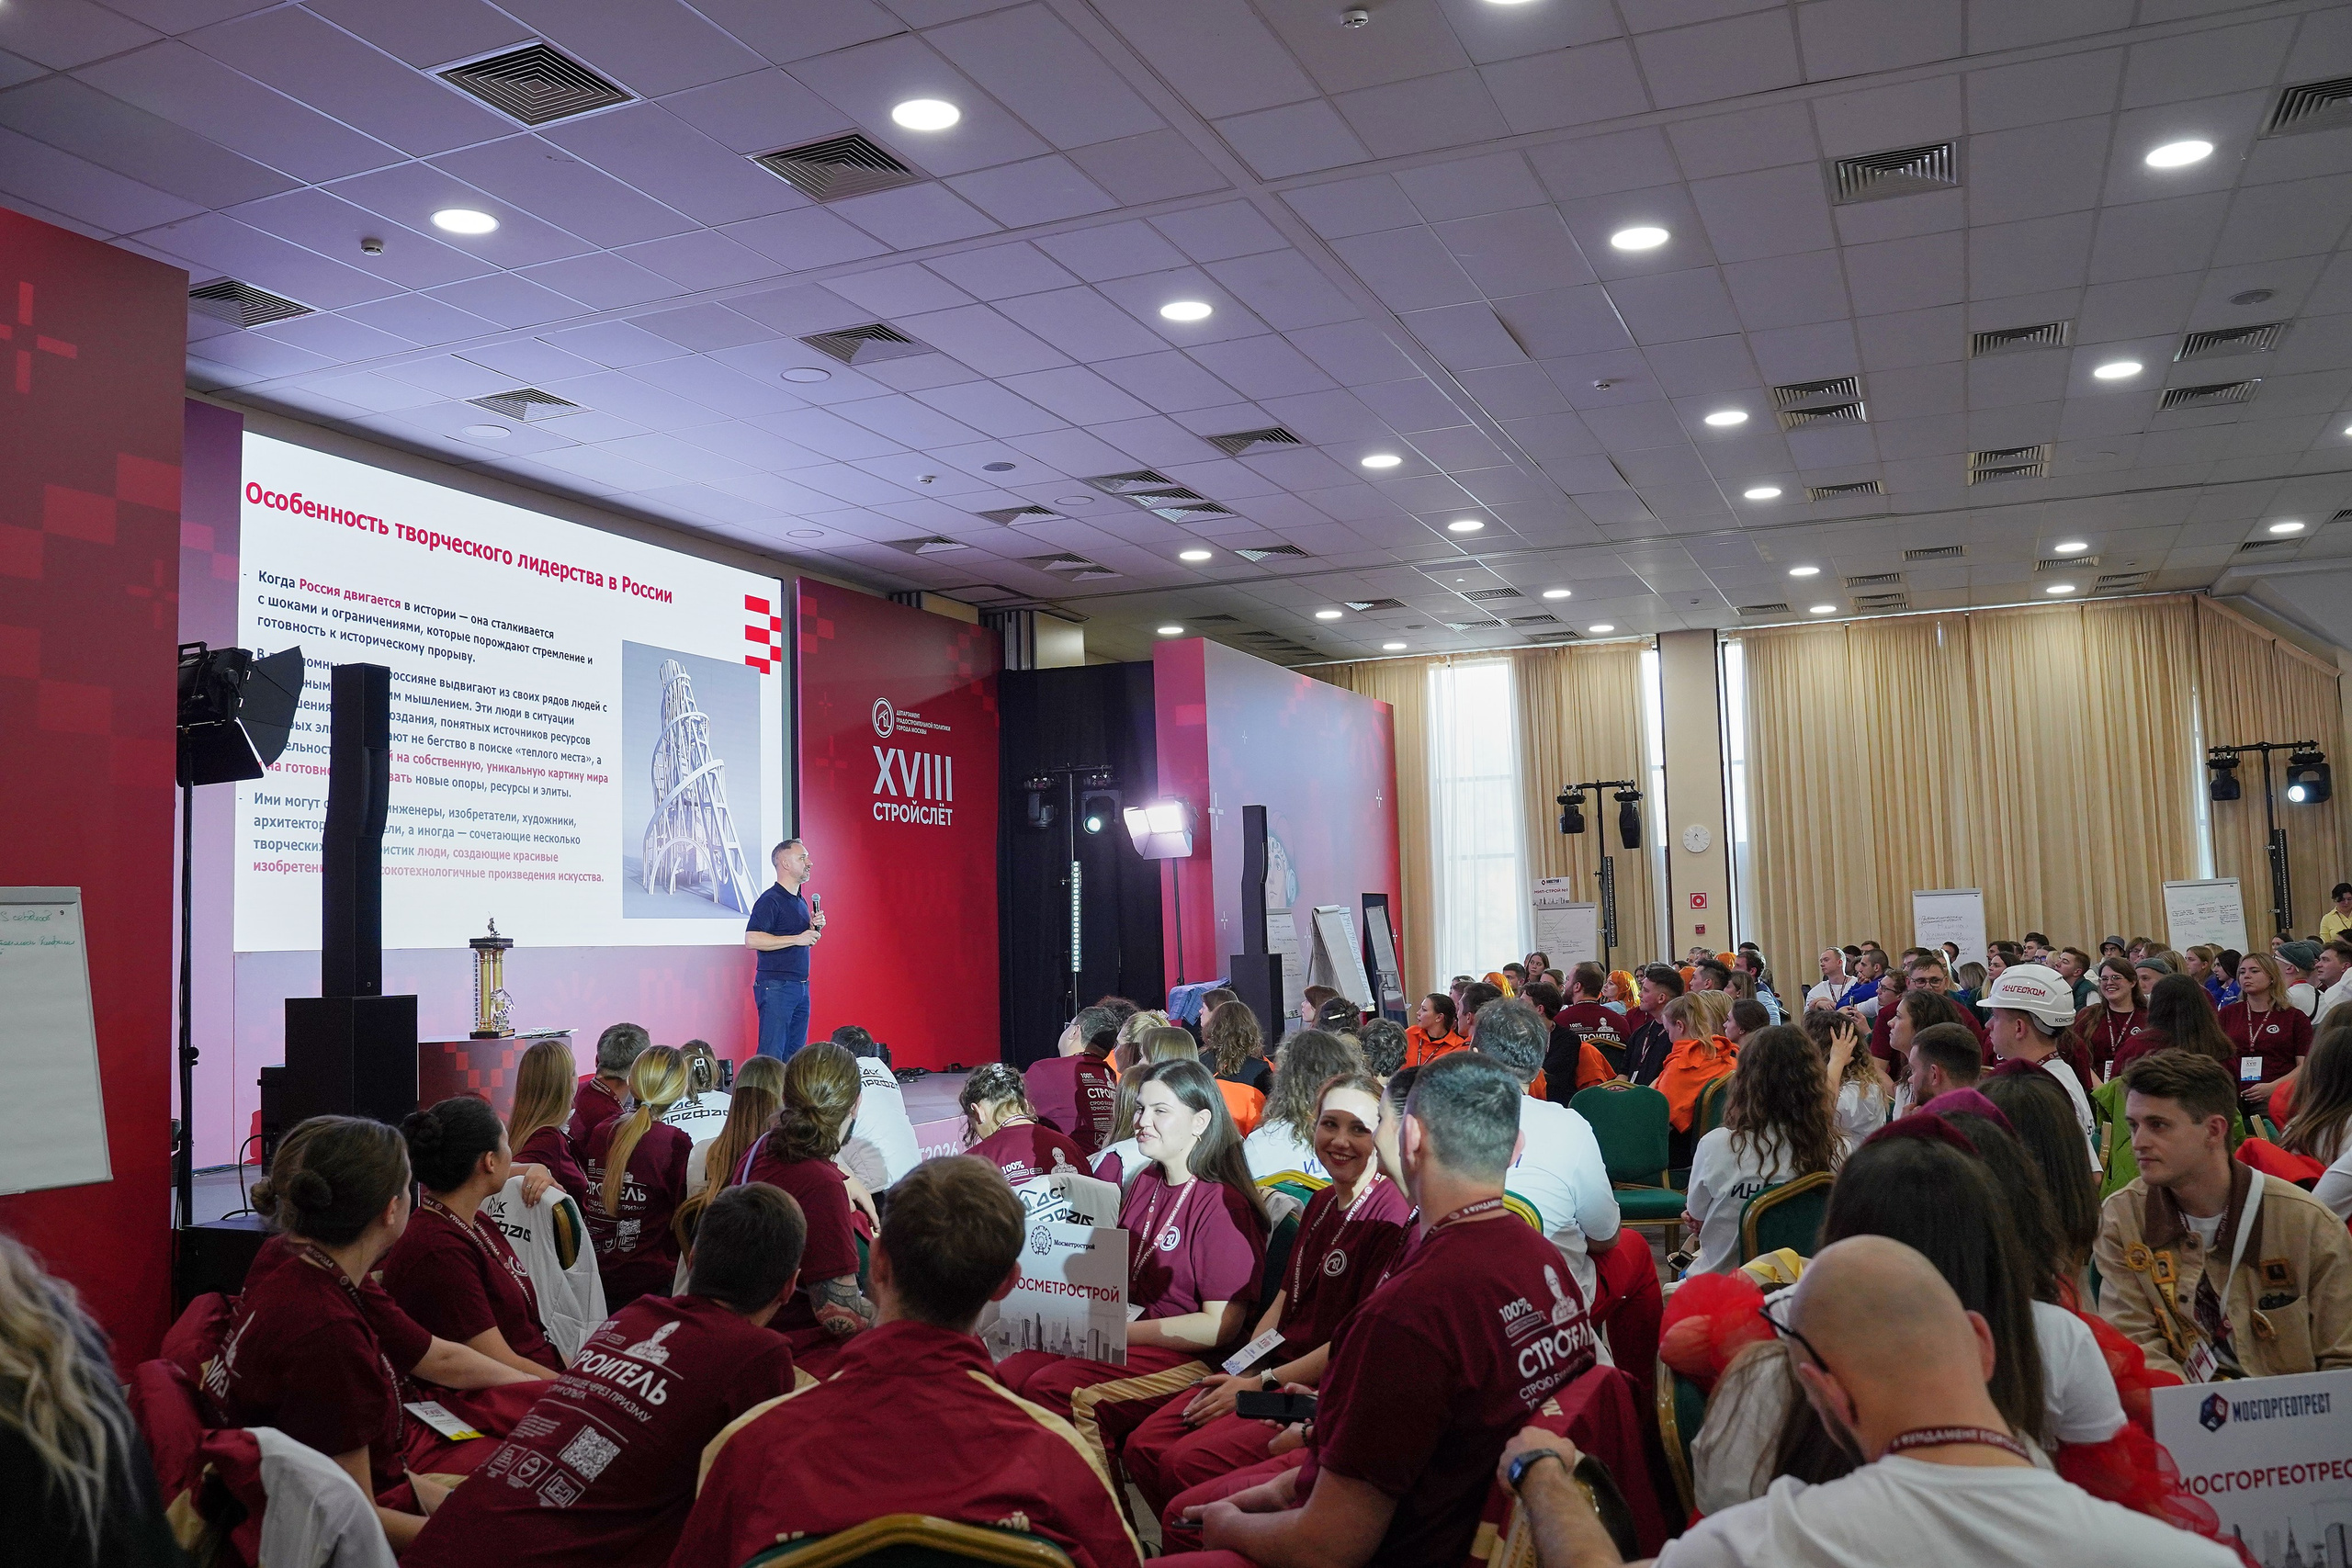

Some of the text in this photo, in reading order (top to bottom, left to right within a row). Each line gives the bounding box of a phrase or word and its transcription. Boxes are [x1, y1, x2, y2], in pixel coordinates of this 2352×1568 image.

[245, 481, 672, 604] Особенность творческого лидерства в России
[258, 570, 295, 589] Когда
[299, 578, 340, 597] Россия
[343, 589, 401, 609] двигается
[403, 602, 410, 610] в
[413, 604, 456, 619] истории
[470, 615, 488, 626] она
[491, 619, 554, 638] сталкивается
[257, 594, 264, 604] с
[267, 596, 317, 614] шоками
[321, 606, 328, 615] и
[332, 608, 423, 636] ограничениями,
[426, 626, 470, 642] которые
[473, 635, 529, 653] порождают
[532, 646, 585, 663] стремление
[257, 616, 475, 664] готовность к историческому прорыву.
[256, 648, 265, 660] В
[439, 679, 496, 695] выдвигают
[499, 688, 510, 697] из
[512, 690, 539, 702] своих
[542, 694, 569, 706] рядов
[571, 699, 600, 711] людей
[404, 693, 471, 711] мышлением.
[474, 701, 492, 714] Эти
[494, 706, 521, 718] люди
[524, 710, 529, 718] в
[532, 712, 574, 725] ситуации
[389, 710, 436, 728] оздания,
[440, 717, 490, 732] понятных
[492, 725, 548, 739] источников
[550, 732, 590, 745] ресурсов
[411, 734, 424, 744] не
[426, 734, 467, 749] бегство
[469, 741, 475, 750] в
[478, 742, 512, 754] поиске
[514, 747, 558, 760] «теплого
[560, 752, 594, 765] места»,
[596, 756, 601, 764] а
[285, 762, 330, 776] готовн
[415, 775, 448, 786] новые
[451, 778, 487, 792] опоры,
[490, 782, 529, 795] ресурсы
[540, 786, 571, 797] элиты.
[396, 753, 409, 762] на
[413, 753, 483, 773] собственную,
[486, 762, 545, 778] уникальную
[548, 769, 584, 783] картину
[586, 773, 608, 784] мира
[873, 745, 953, 802] XVIII
[254, 792, 280, 806] Ими
[285, 796, 320, 810] могут
[448, 807, 519, 824] изобретатели,
[522, 814, 576, 828] художники,
[873, 800, 953, 826] СТРОЙСЛЁТ
[254, 816, 325, 832] архитектор
[408, 826, 413, 835] а
[417, 827, 454, 839] иногда
[469, 829, 530, 842] сочетающие
[533, 834, 580, 844] несколько
[417, 847, 449, 859] люди,
[453, 849, 510, 861] создающие
[513, 852, 558, 863] красивые
[488, 870, 555, 881] произведения
[558, 873, 604, 883] искусства.
[1001, 1160, 1025, 1175] 100%
[1054, 1239, 1096, 1250] Мосметрострой
[1013, 1277, 1120, 1303] ОСМЕТРОСТРОЙ
[1498, 1297, 1533, 1324] 100%
[571, 1349, 668, 1406] РОИТЕЛЬ
[608, 1391, 653, 1423] ПРИЗМУ
[2232, 1392, 2332, 1423] МОСГОРГЕОТРЕСТ
[2177, 1457, 2352, 1495] МОСГОРГЕОТРЕС
